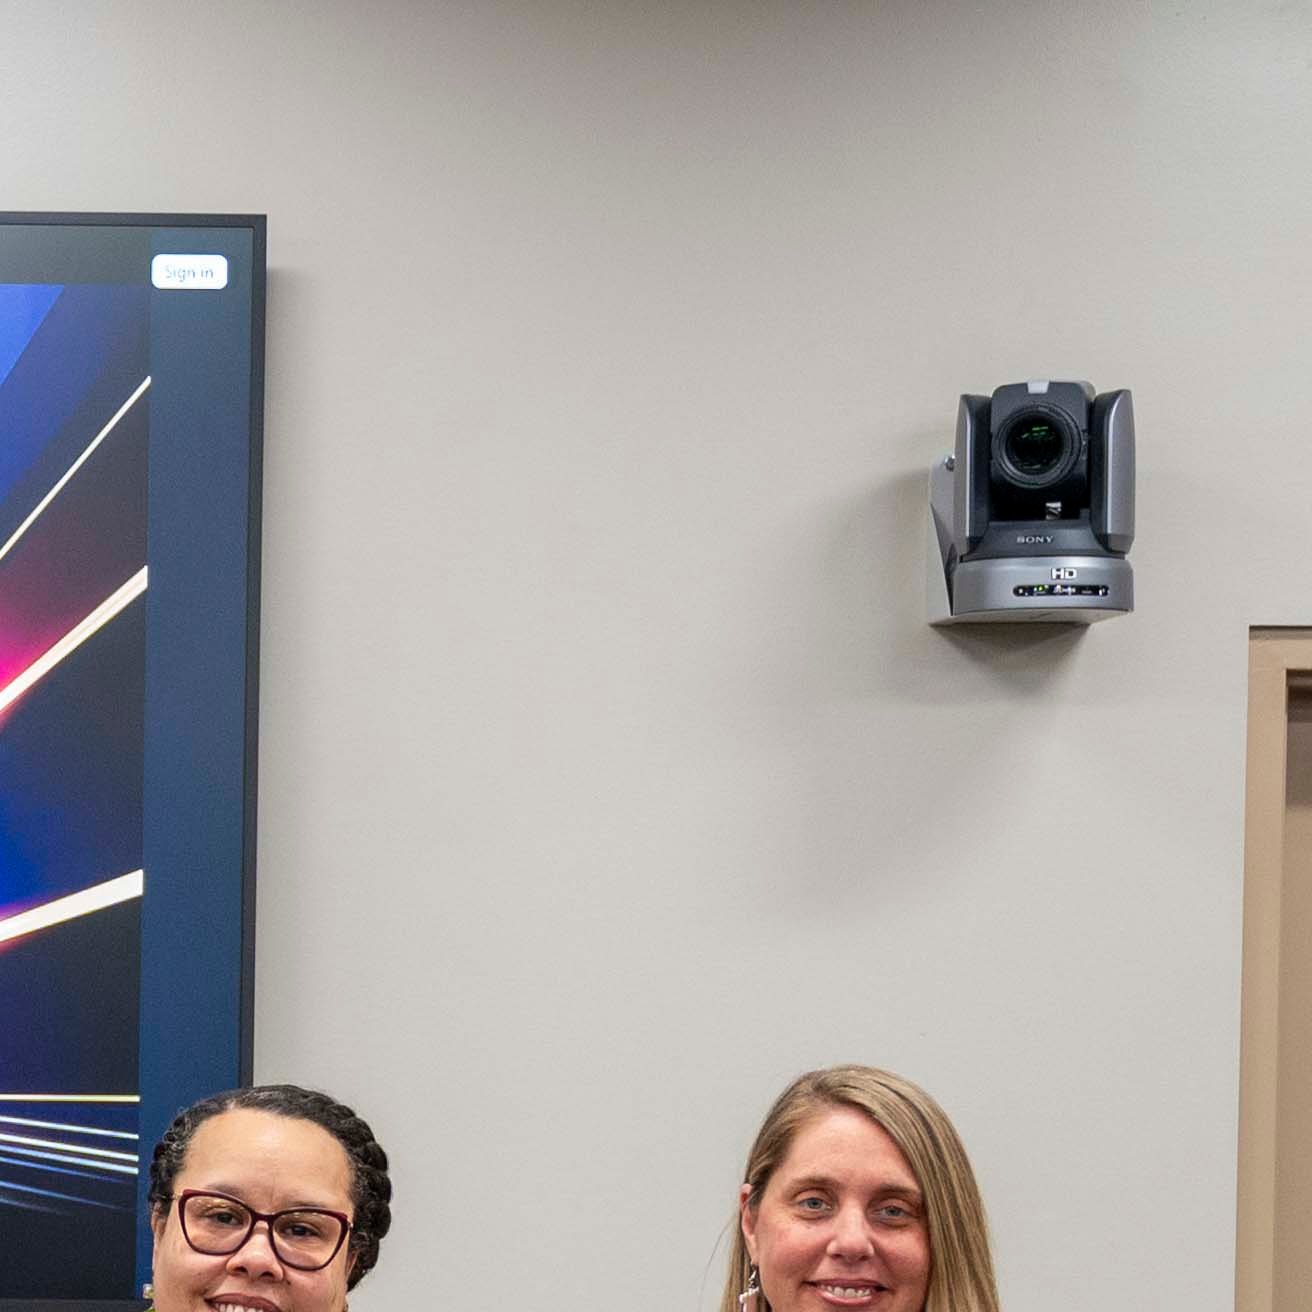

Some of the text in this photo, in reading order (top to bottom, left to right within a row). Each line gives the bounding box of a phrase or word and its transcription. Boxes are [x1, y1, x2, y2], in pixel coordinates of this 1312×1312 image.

[164, 264, 214, 282] Sign in
[1051, 568, 1077, 579] HD
